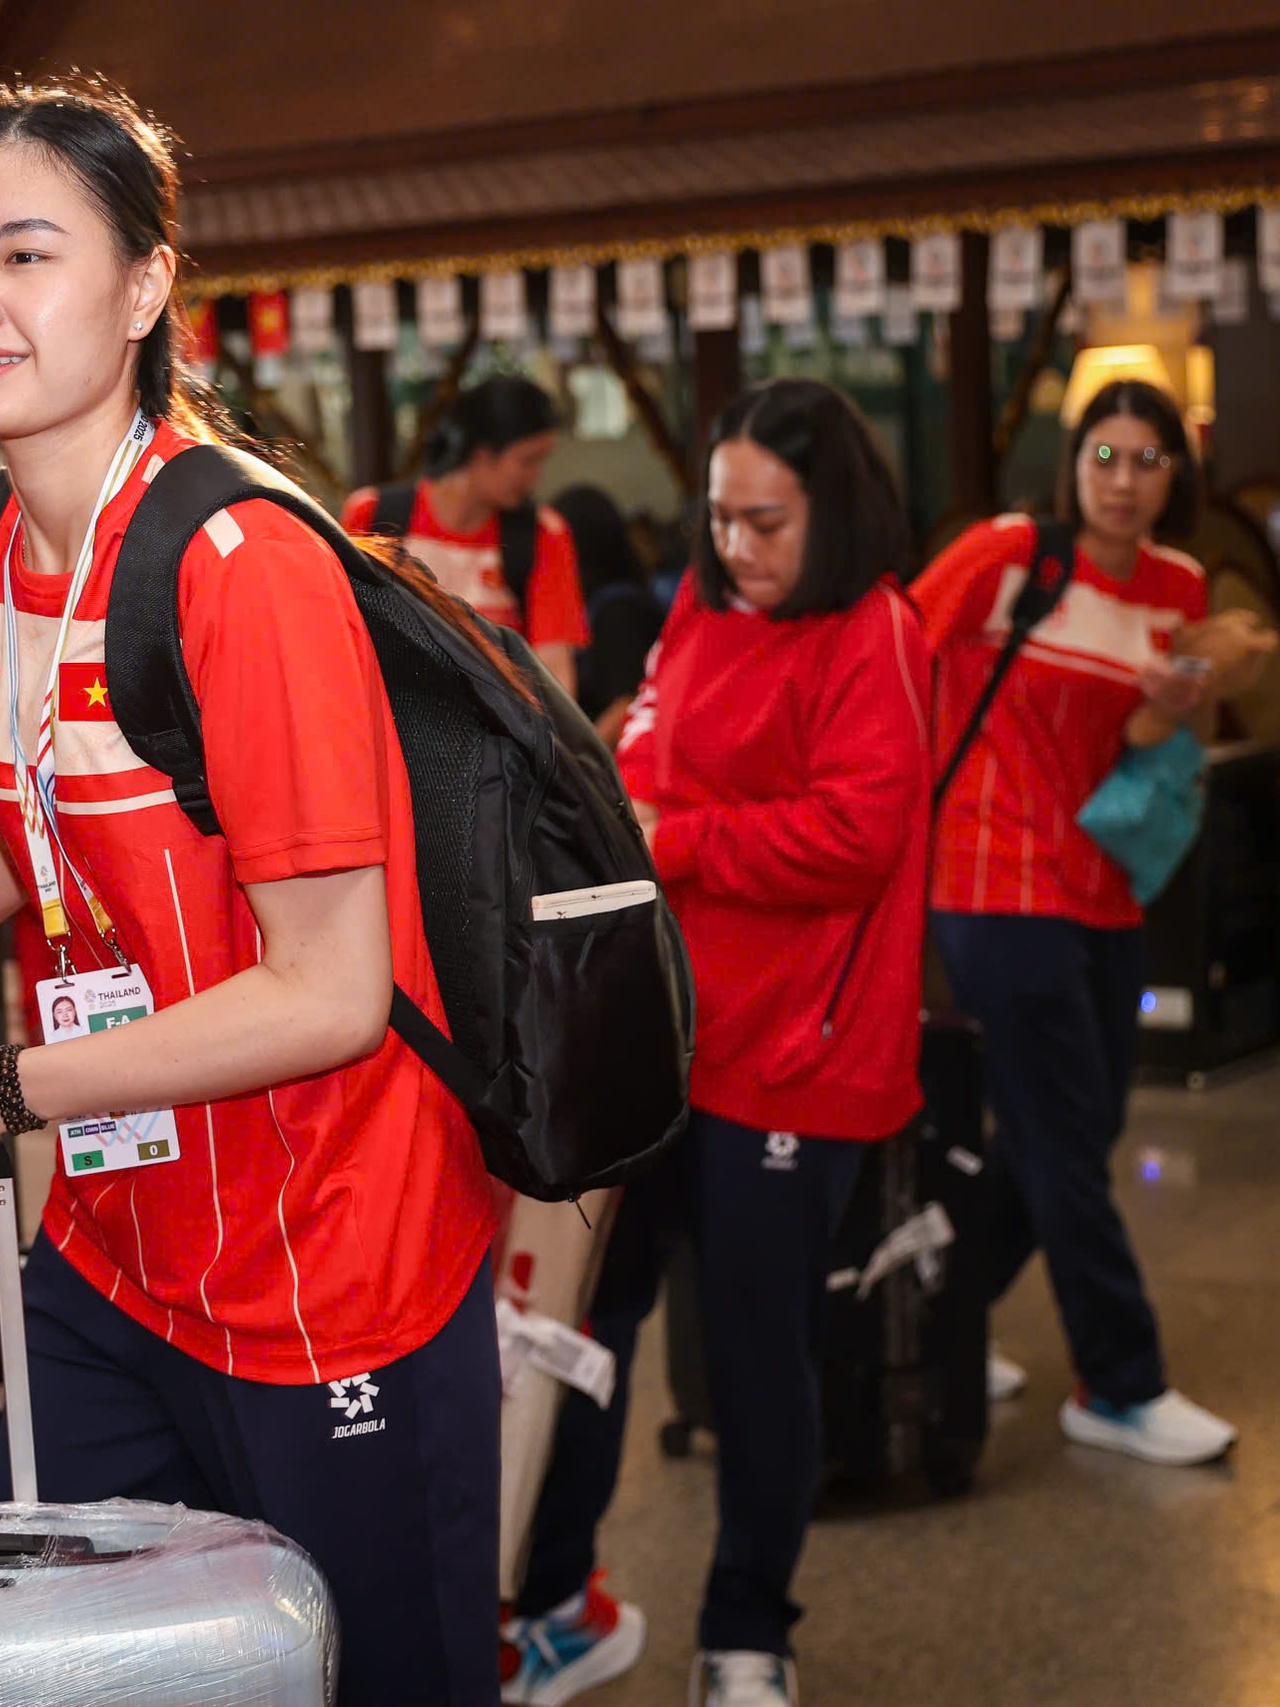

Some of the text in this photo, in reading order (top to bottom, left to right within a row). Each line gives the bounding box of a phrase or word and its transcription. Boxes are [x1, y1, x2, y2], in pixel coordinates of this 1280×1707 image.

[133, 420, 148, 442] 2025
[98, 986, 141, 1001] THAILAND
[84, 1155, 93, 1166] S
[332, 1418, 386, 1439] JOGARBOLA
